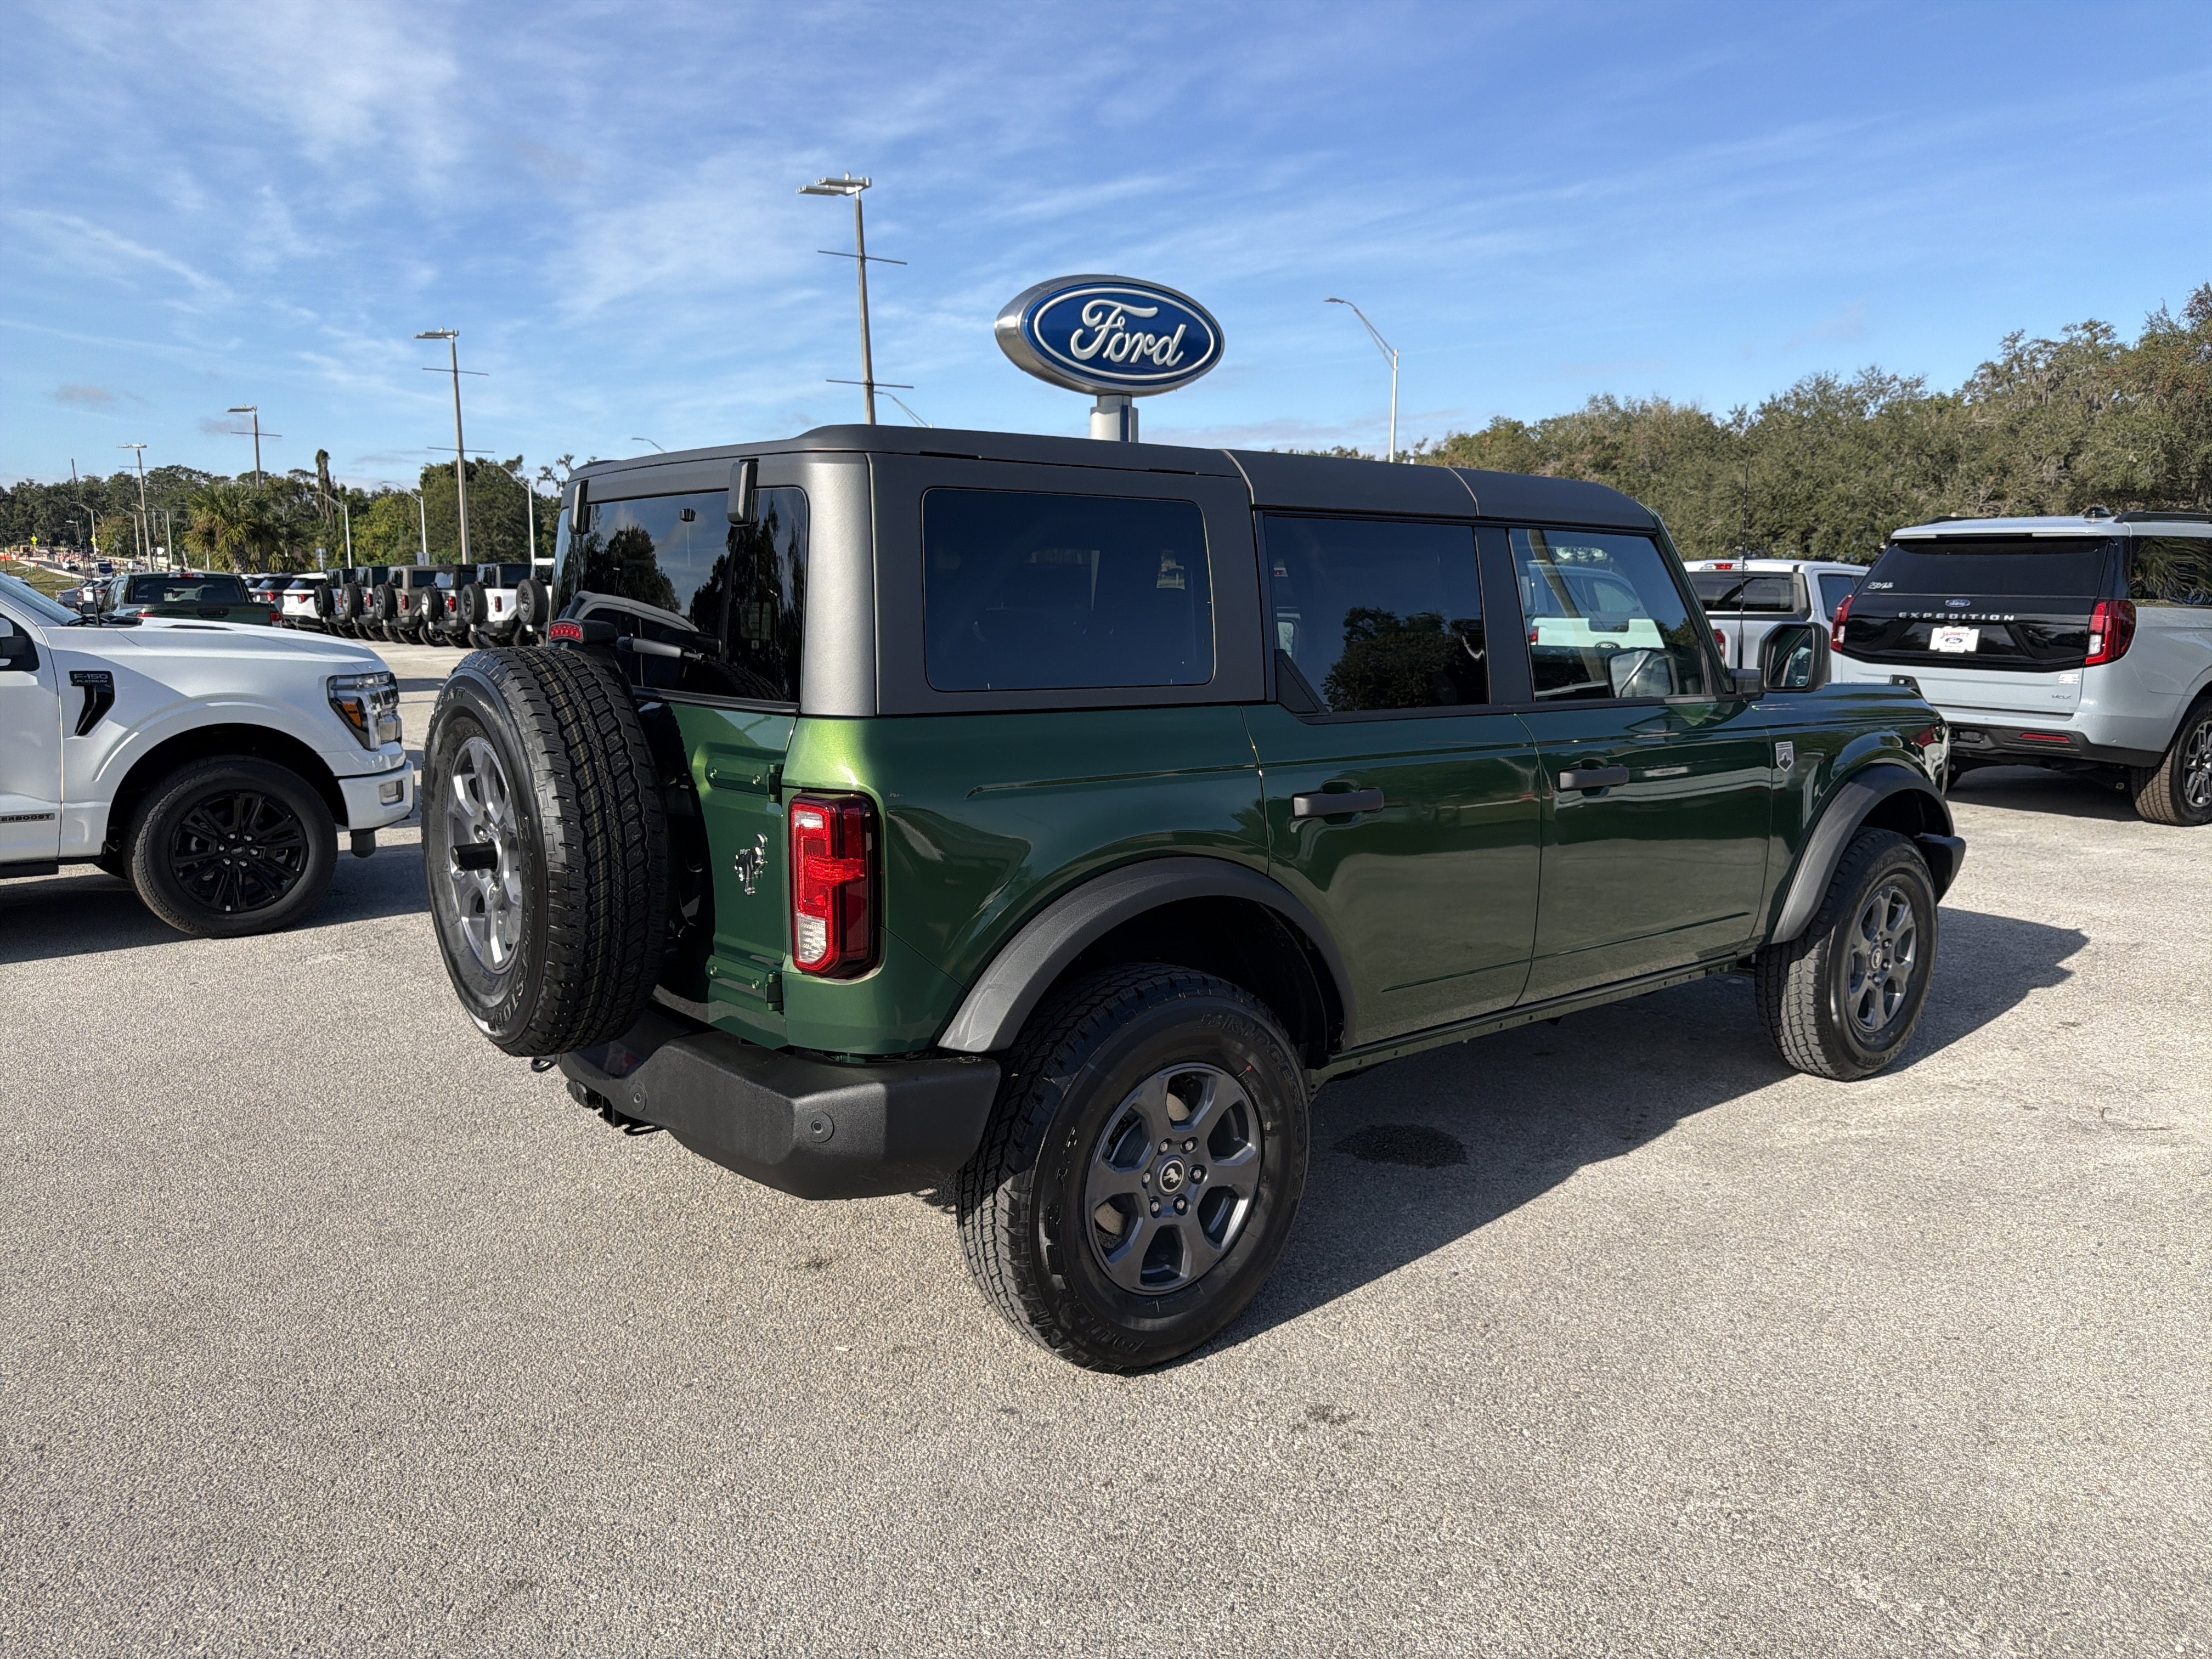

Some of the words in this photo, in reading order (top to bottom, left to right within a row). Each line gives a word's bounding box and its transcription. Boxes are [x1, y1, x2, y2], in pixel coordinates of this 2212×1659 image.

[1070, 300, 1186, 366] Ford
[1898, 612, 2015, 621] EXPEDITION
[1200, 1013, 1307, 1200] BRIDGESTONE
